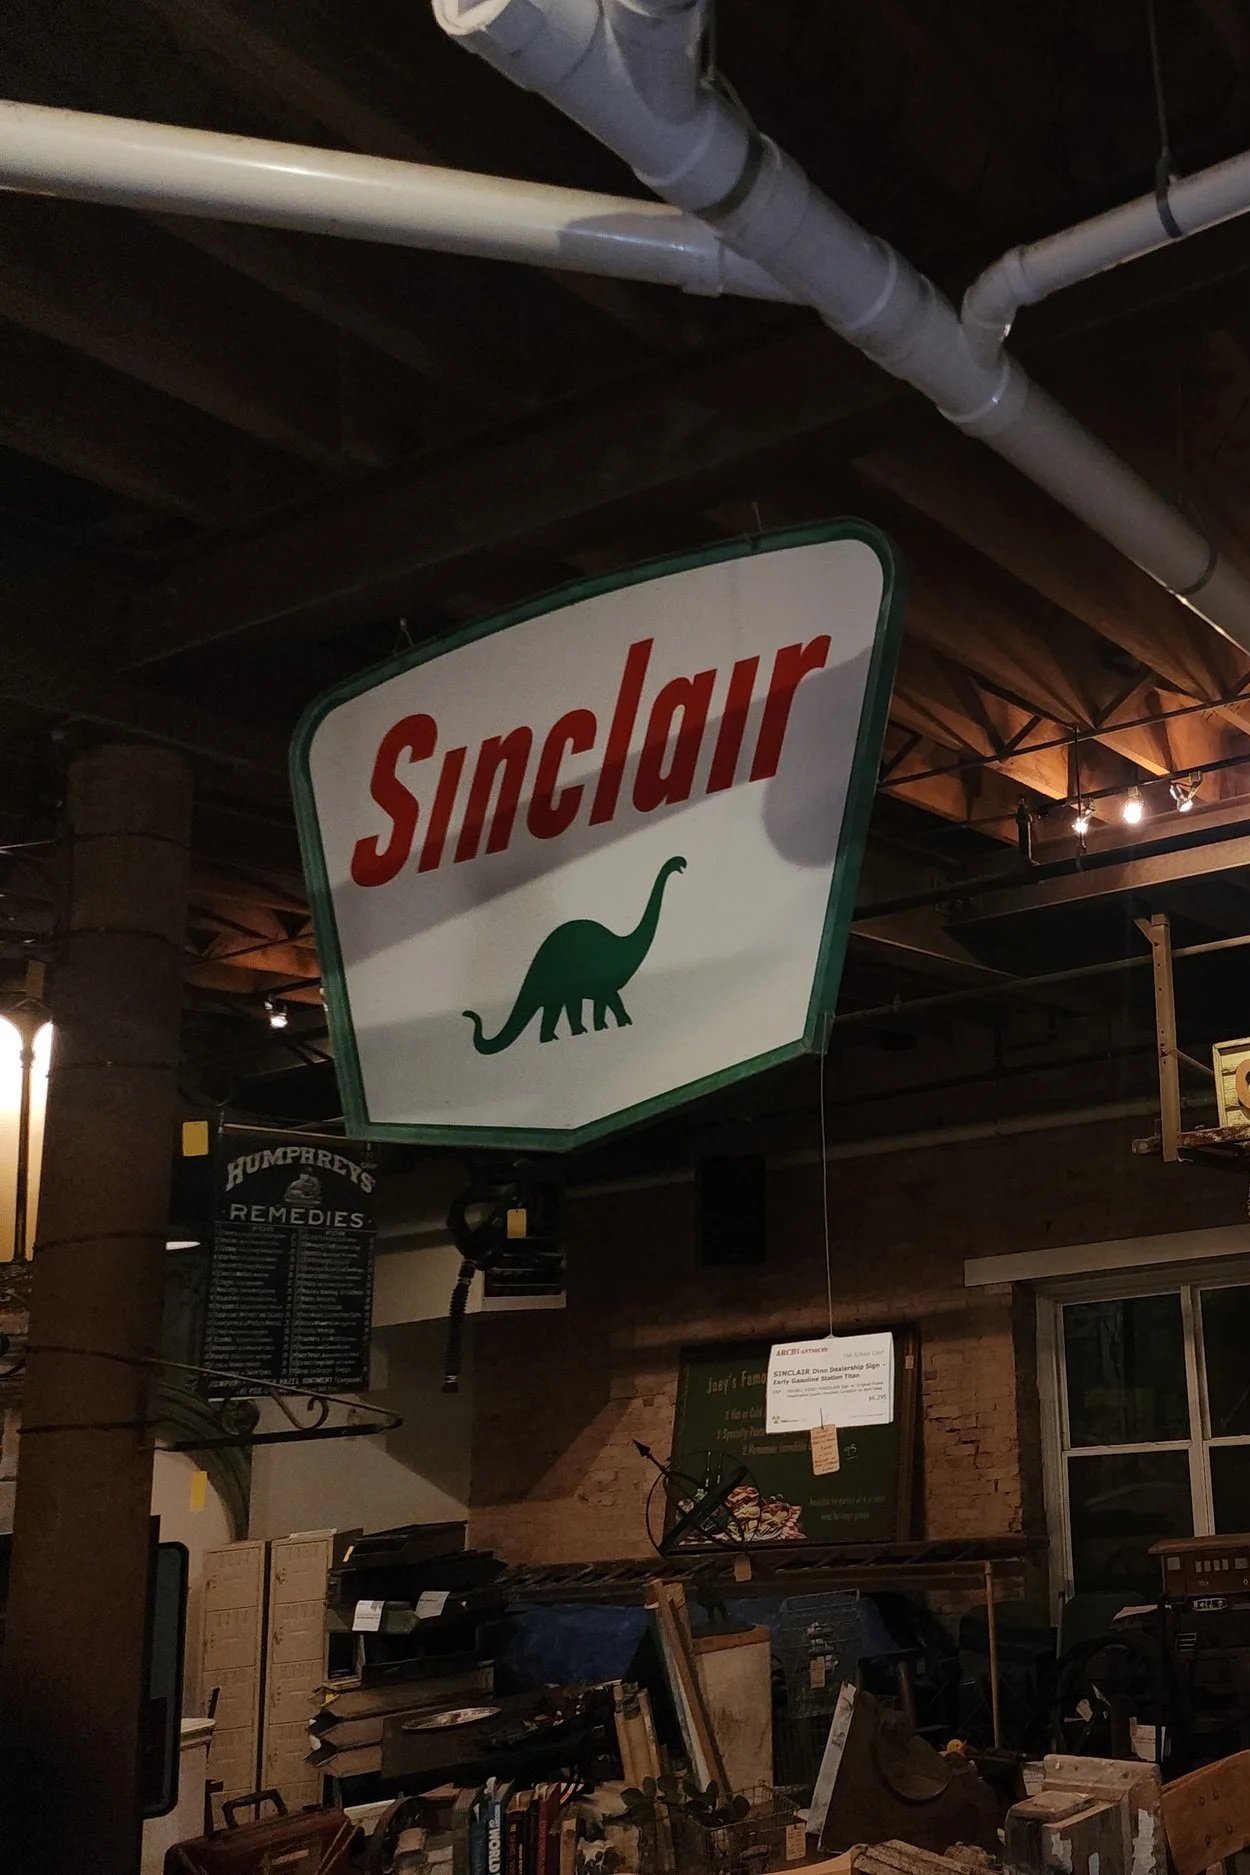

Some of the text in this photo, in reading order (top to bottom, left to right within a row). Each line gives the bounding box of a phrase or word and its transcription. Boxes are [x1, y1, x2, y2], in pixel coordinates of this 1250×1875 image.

[350, 634, 832, 888] Sinclair
[228, 1203, 366, 1230] REMEDIES
[773, 1369, 810, 1378] SINCLAIR
[812, 1367, 828, 1375] Dino
[829, 1364, 864, 1373] Dealership
[865, 1362, 881, 1370] Sign
[821, 1374, 843, 1382] Station
